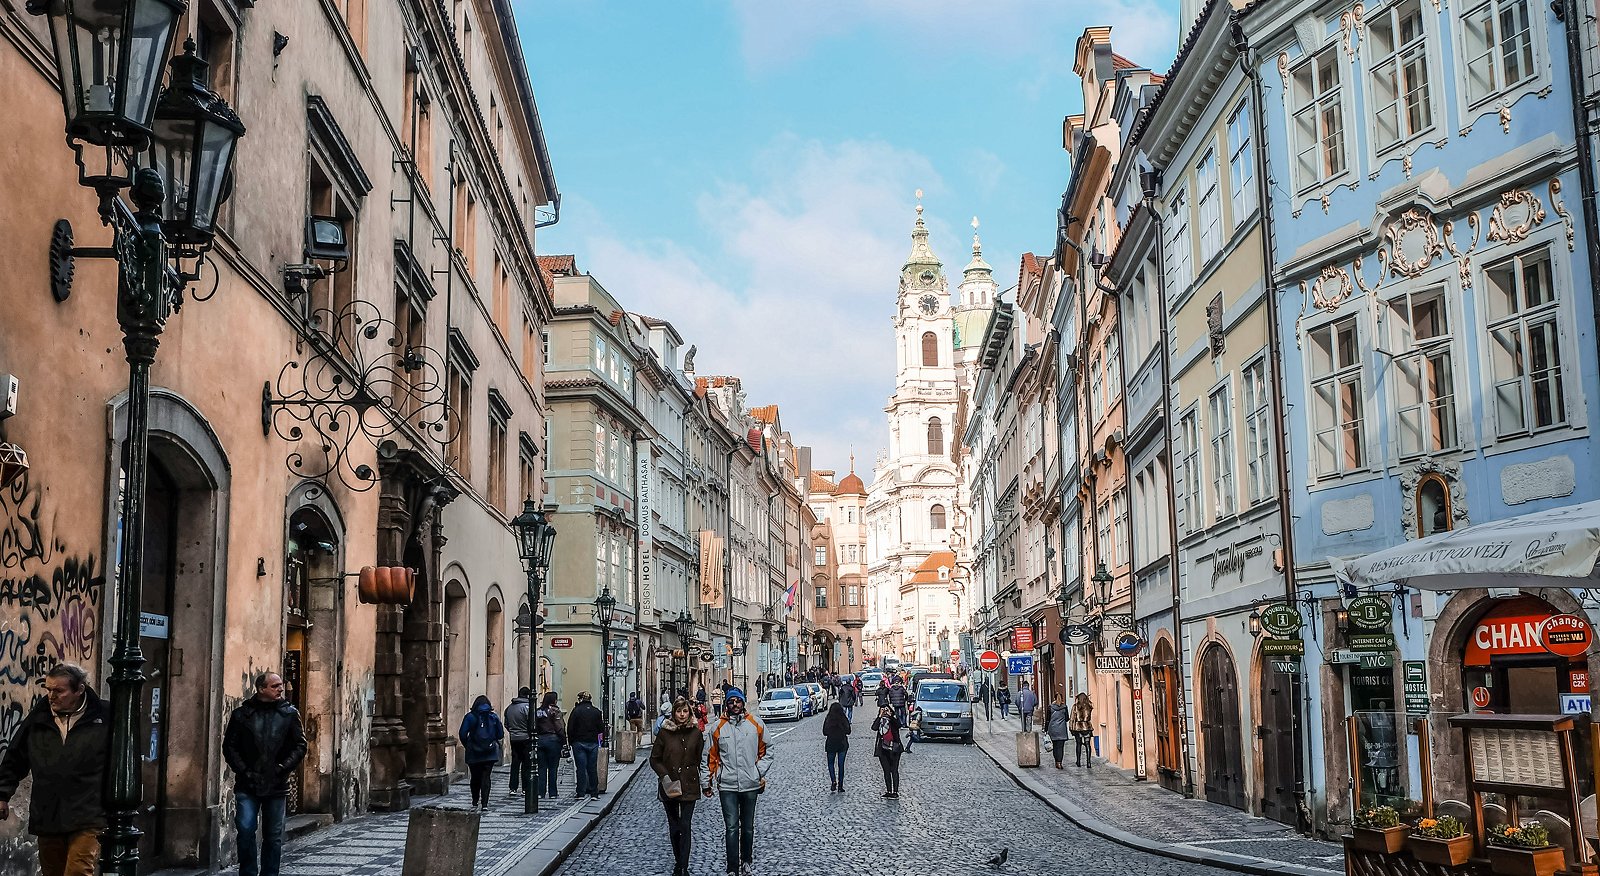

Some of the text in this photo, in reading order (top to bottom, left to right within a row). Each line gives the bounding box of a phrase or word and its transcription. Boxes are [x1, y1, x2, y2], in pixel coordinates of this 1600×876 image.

[640, 458, 649, 505] BALTHASAR
[1443, 546, 1475, 560] POD
[642, 549, 650, 581] HOTEL
[1211, 542, 1245, 591] Jewellery
[643, 583, 651, 616] DESIGN
[1352, 598, 1374, 609] TOURIST
[1265, 606, 1285, 617] TOURIST
[1546, 617, 1585, 631] change
[1096, 656, 1130, 669] CHANGE
[1366, 655, 1386, 667] WC
[1277, 662, 1296, 673] WC
[1352, 675, 1380, 686] TOURIST
[1572, 680, 1586, 688] CZK
[1404, 683, 1428, 692] HOSTEL
